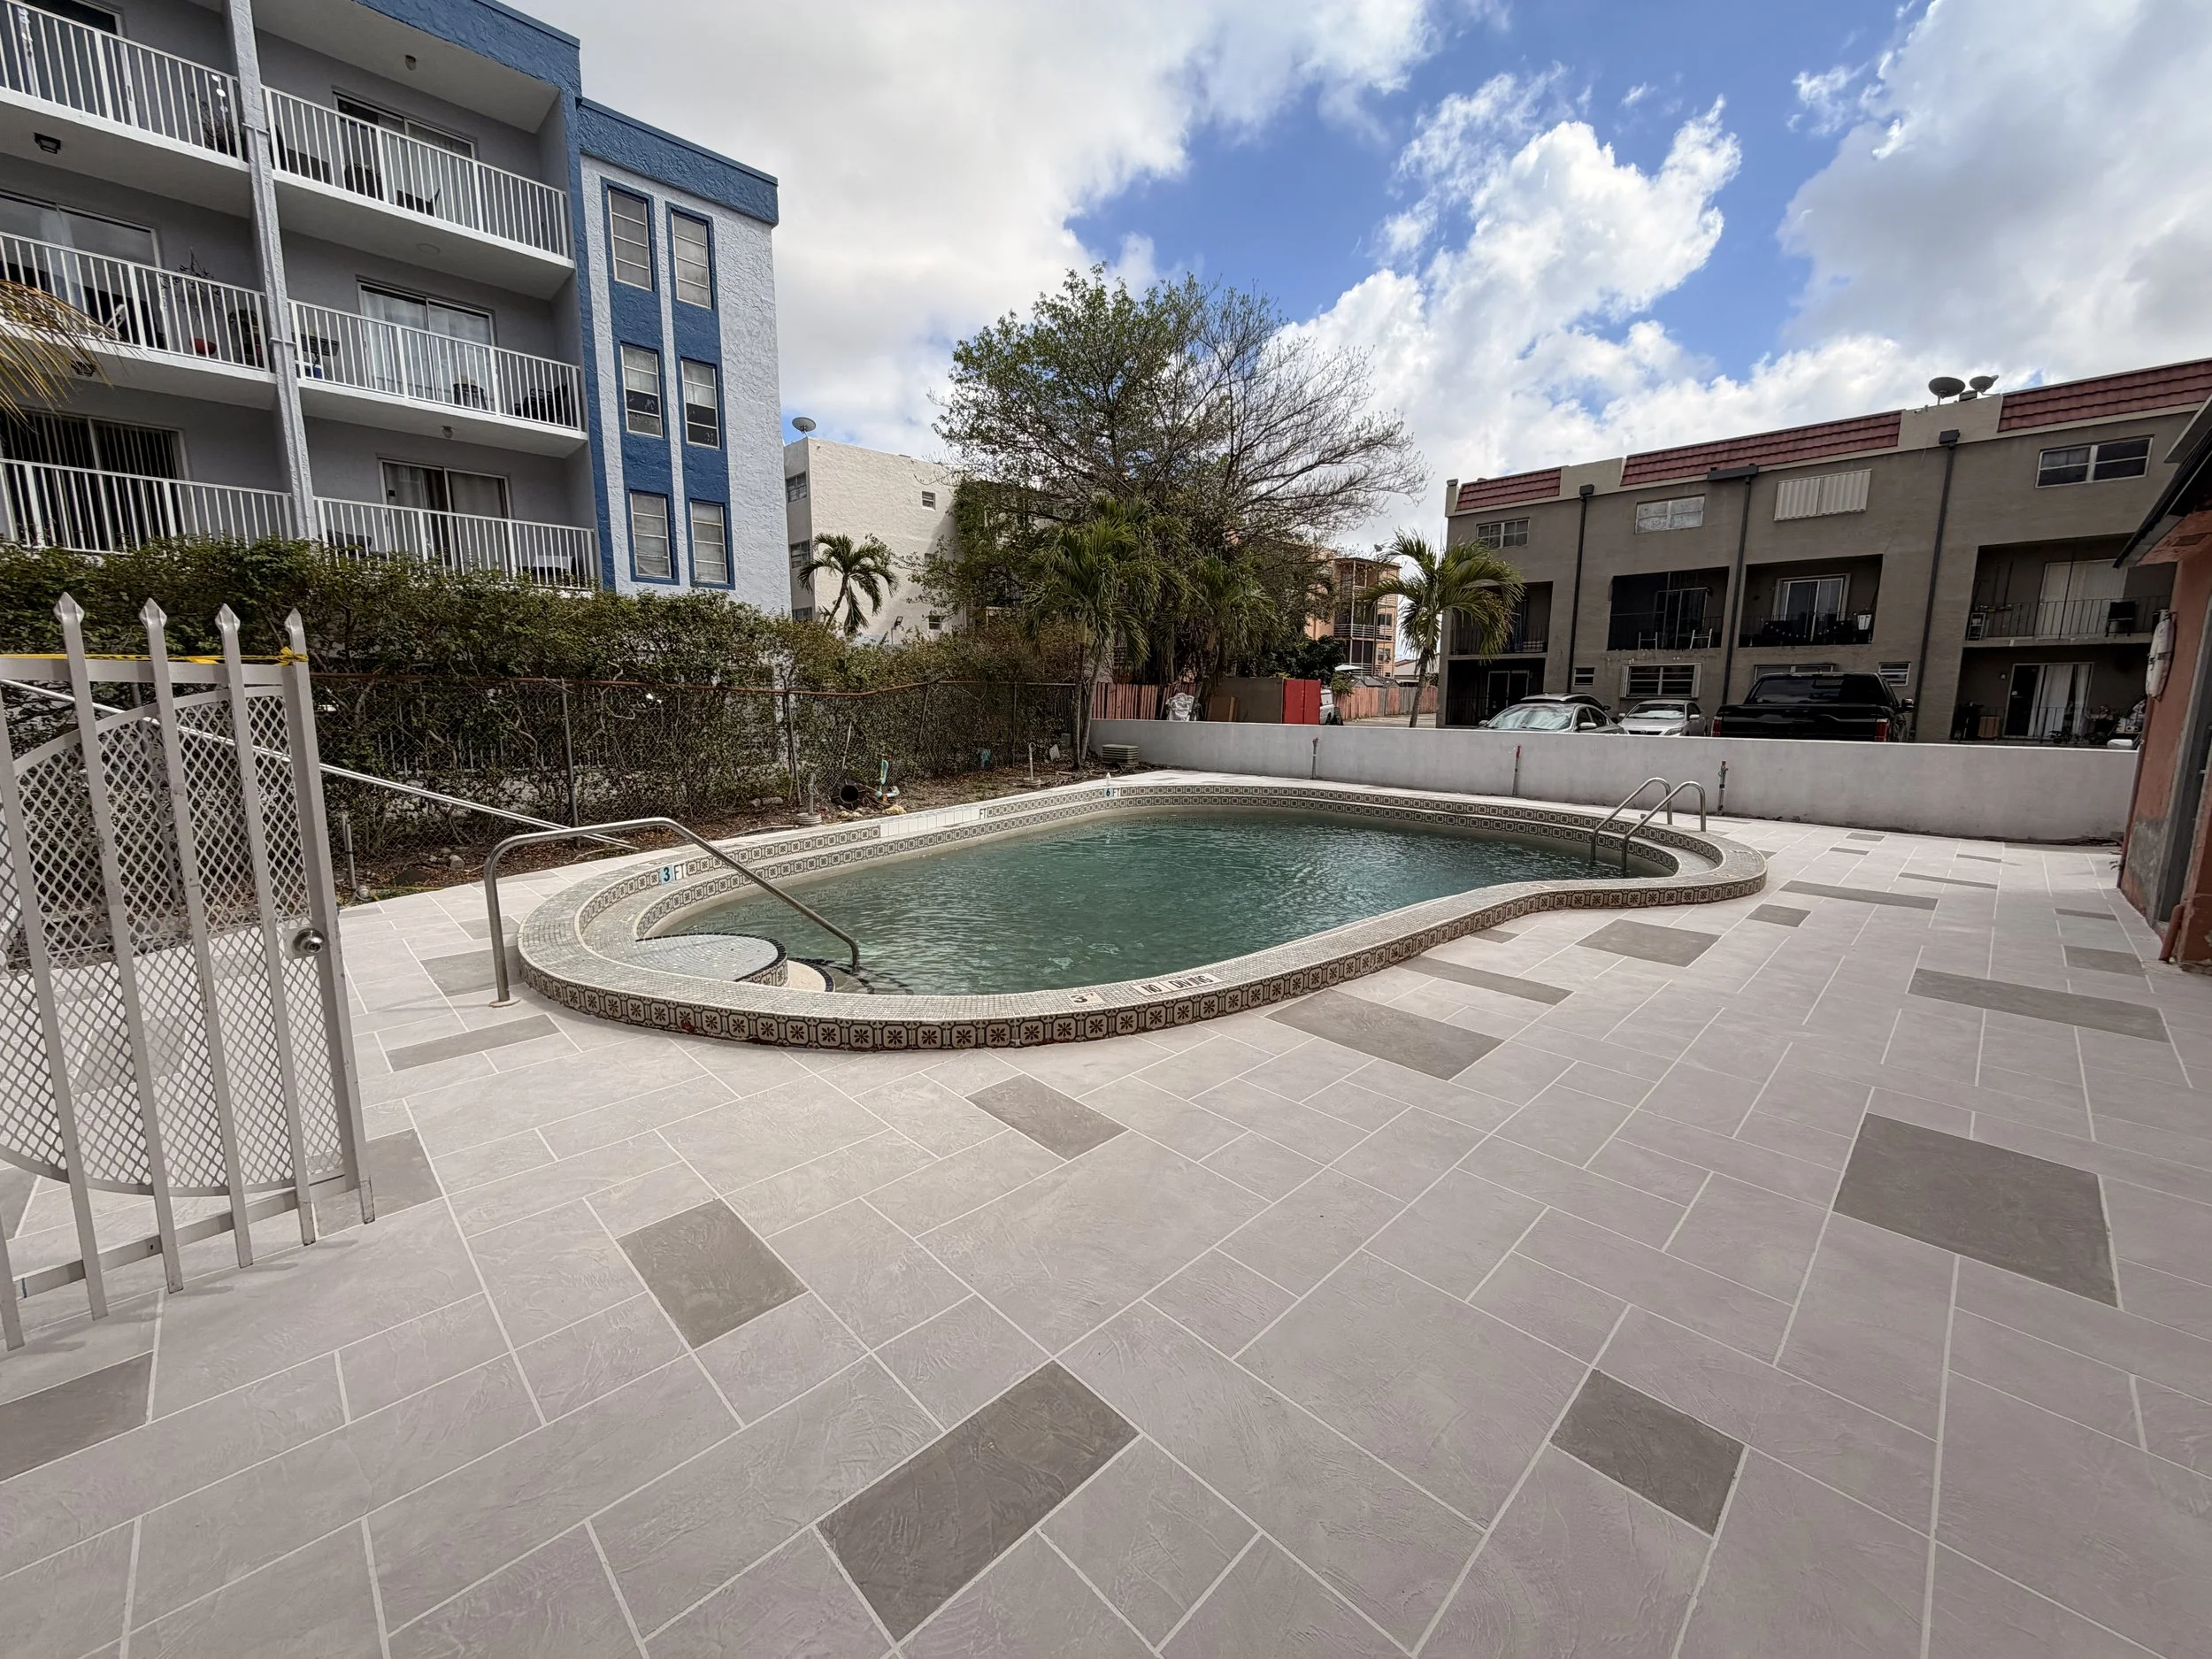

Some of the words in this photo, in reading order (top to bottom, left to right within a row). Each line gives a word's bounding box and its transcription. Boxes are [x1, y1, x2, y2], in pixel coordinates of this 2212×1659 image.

[1106, 787, 1110, 797] 6
[1113, 787, 1120, 797] FT
[663, 866, 671, 882] 3
[673, 863, 686, 880] FT
[1141, 984, 1163, 994] NO
[1168, 975, 1214, 988] DIVING
[1071, 995, 1088, 1003] 3
